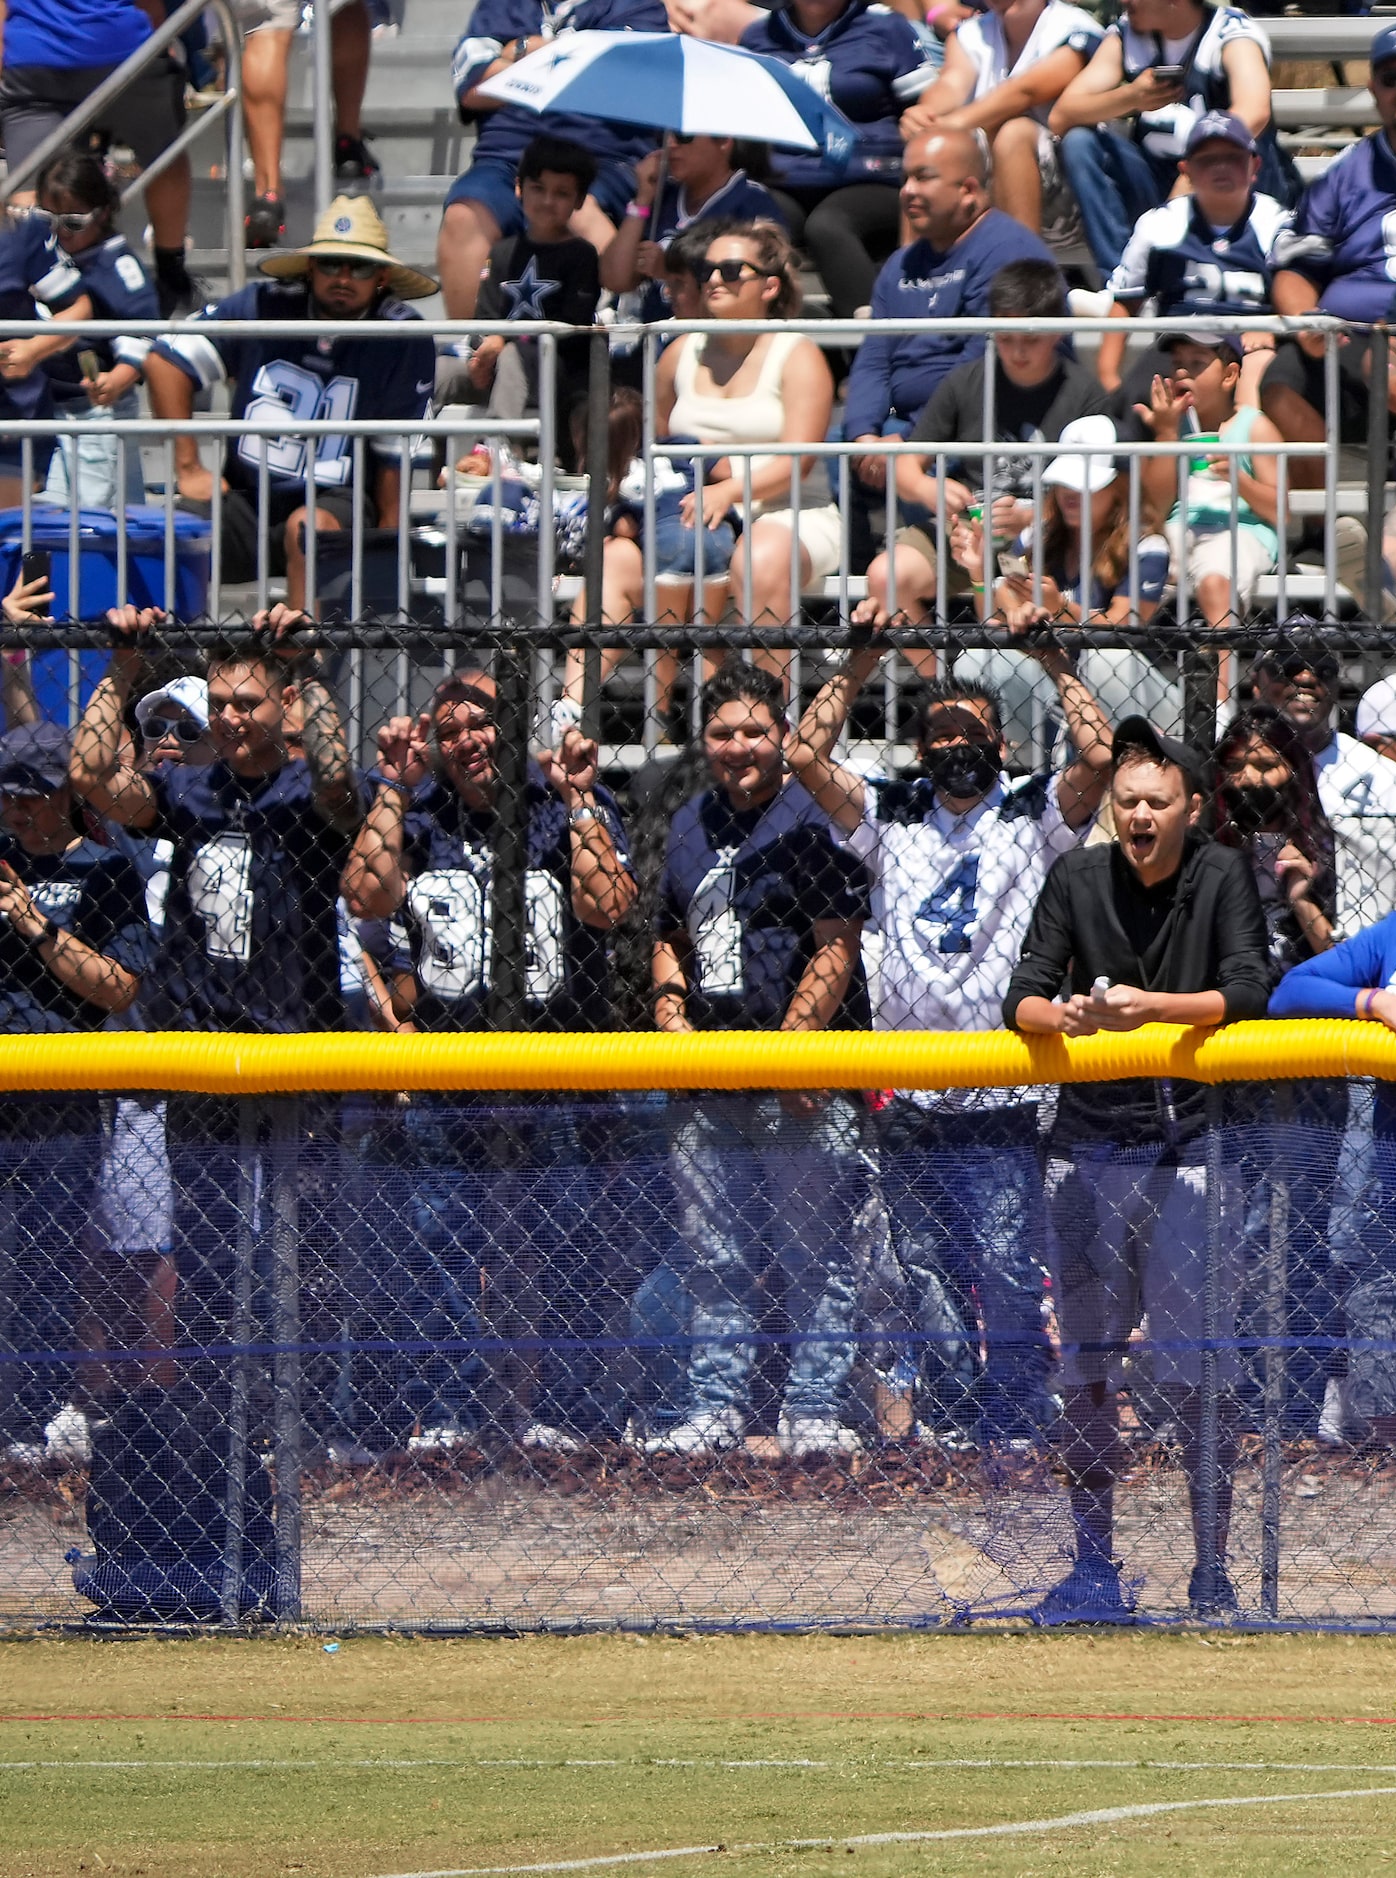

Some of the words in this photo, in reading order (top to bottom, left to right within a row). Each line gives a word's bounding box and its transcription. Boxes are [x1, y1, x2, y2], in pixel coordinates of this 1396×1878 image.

[238, 359, 363, 485] 21
[190, 831, 253, 961] 4
[688, 866, 745, 993] 4
[916, 853, 980, 953] 4
